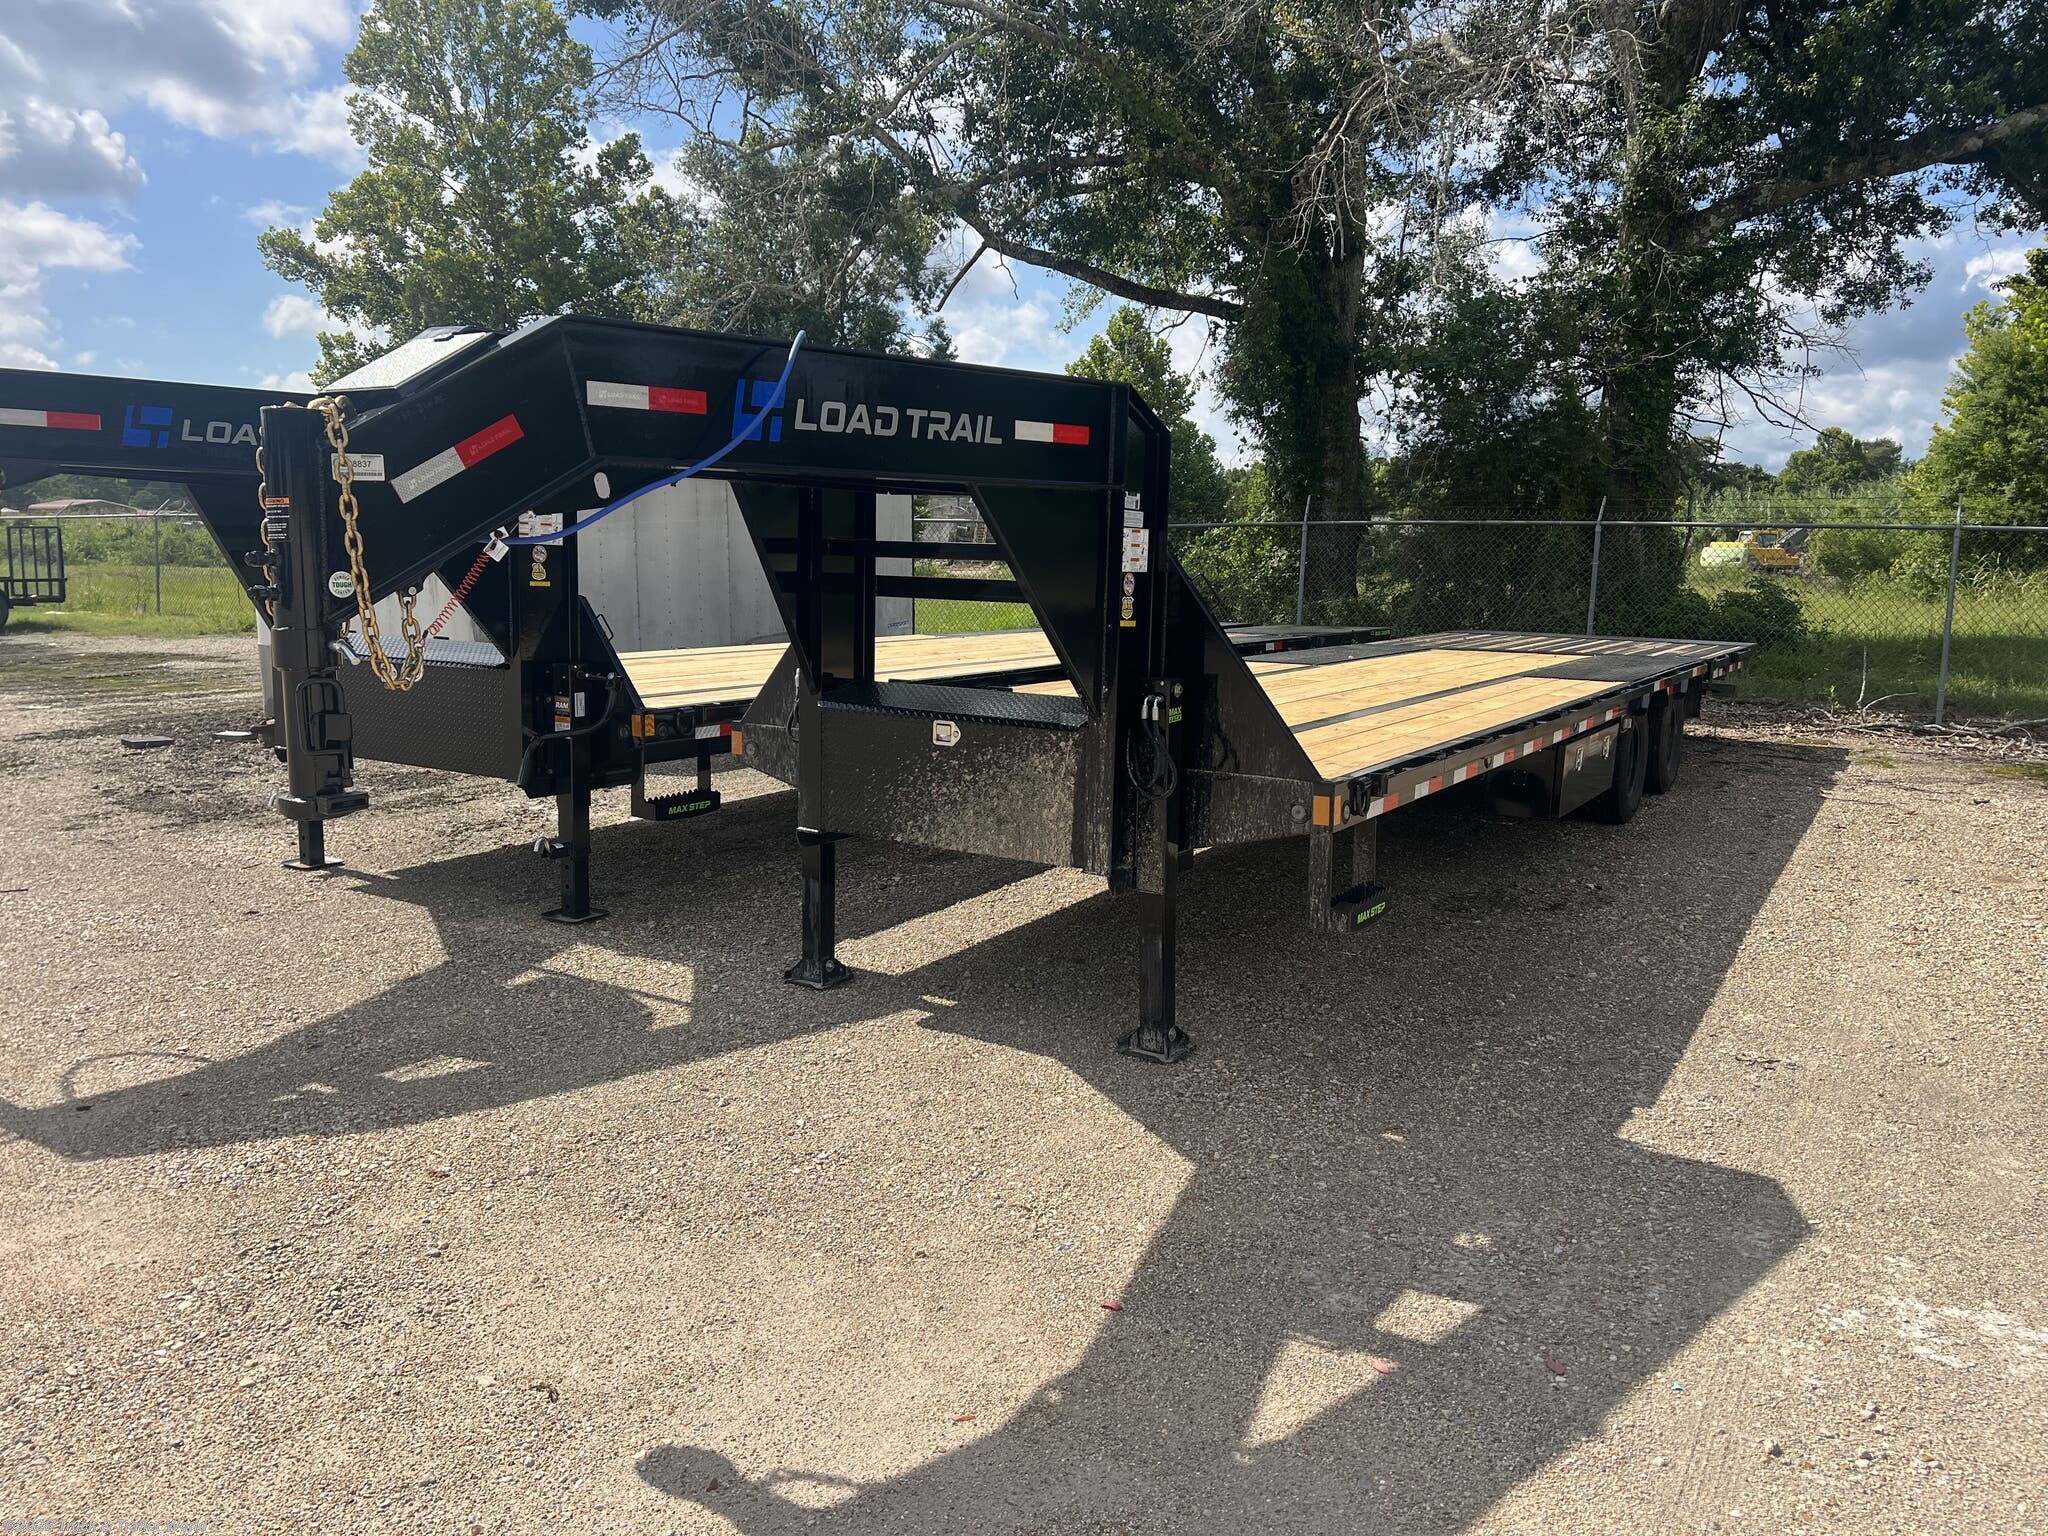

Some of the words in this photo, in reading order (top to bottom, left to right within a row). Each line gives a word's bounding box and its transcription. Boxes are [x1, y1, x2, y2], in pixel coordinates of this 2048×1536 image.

[794, 398, 899, 437] LOAD
[906, 408, 1003, 445] TRAIL
[181, 419, 258, 446] LOA
[555, 701, 569, 709] RAM
[1168, 706, 1182, 717] MAX
[668, 804, 688, 815] MAX
[689, 800, 711, 811] STEP
[1356, 908, 1371, 924] MAX
[1370, 901, 1386, 917] STEP
